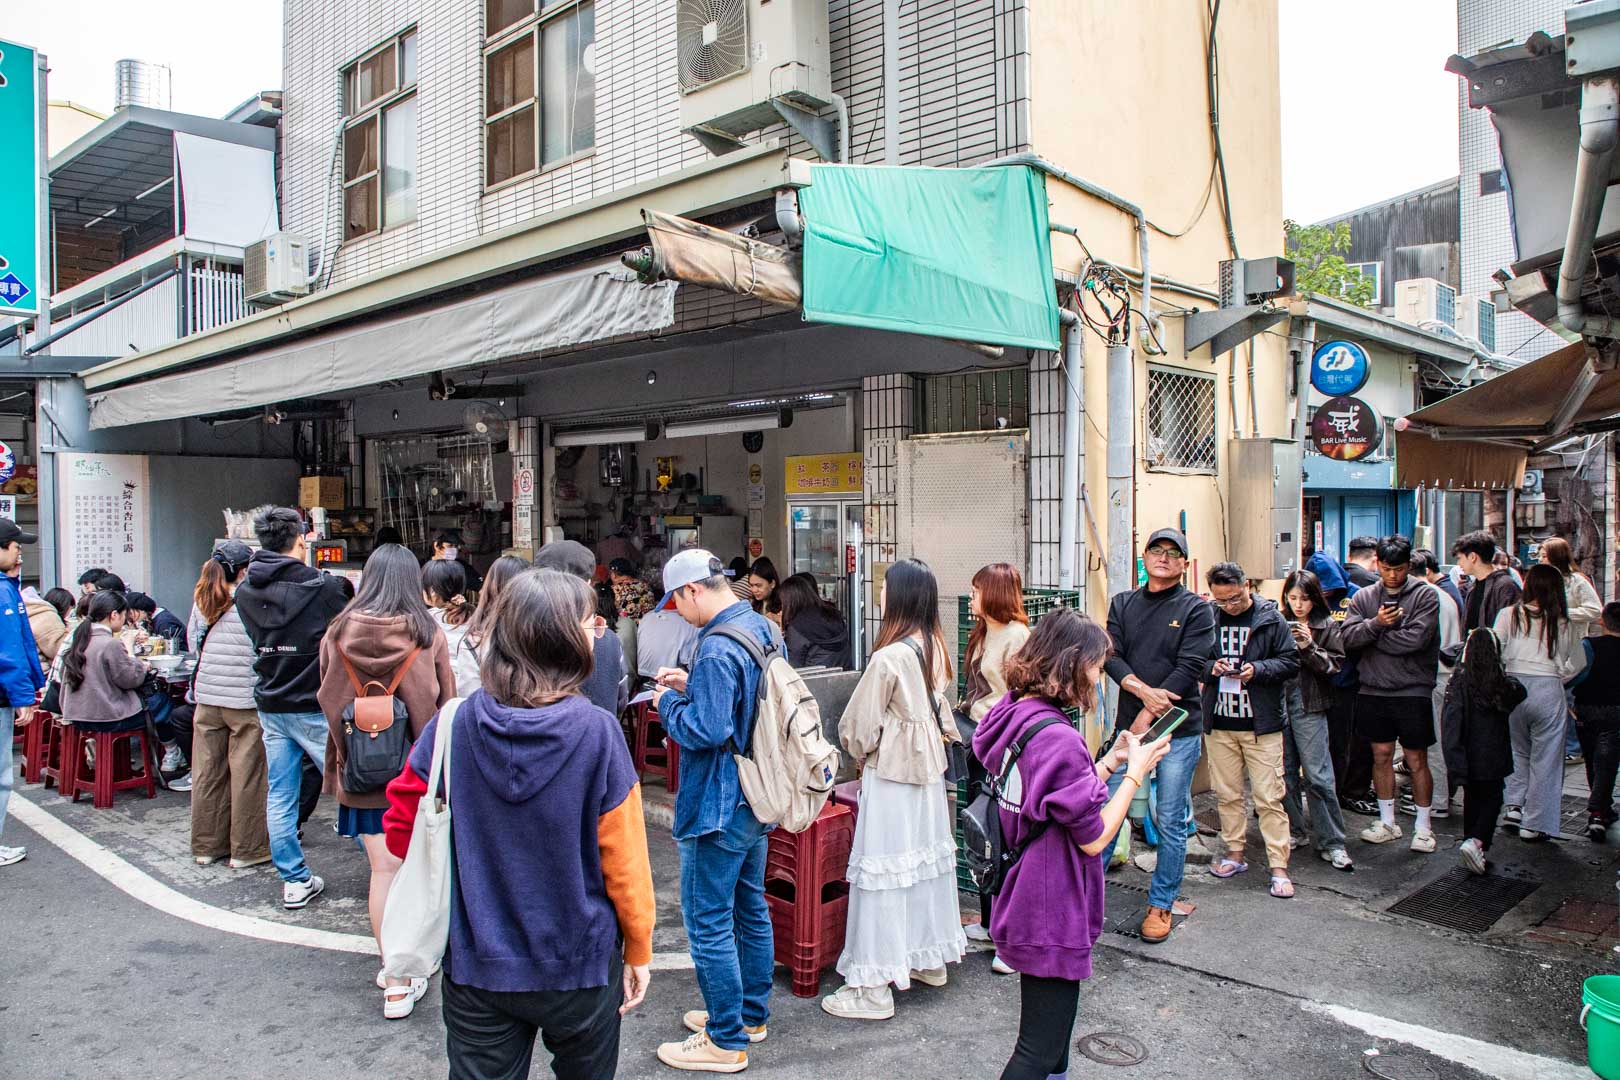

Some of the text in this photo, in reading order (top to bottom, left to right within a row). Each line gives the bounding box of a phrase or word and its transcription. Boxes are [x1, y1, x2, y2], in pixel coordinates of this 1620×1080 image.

[1320, 437, 1335, 445] BAR
[1348, 435, 1368, 443] Music
[122, 489, 134, 553] 綜合杏仁玉露
